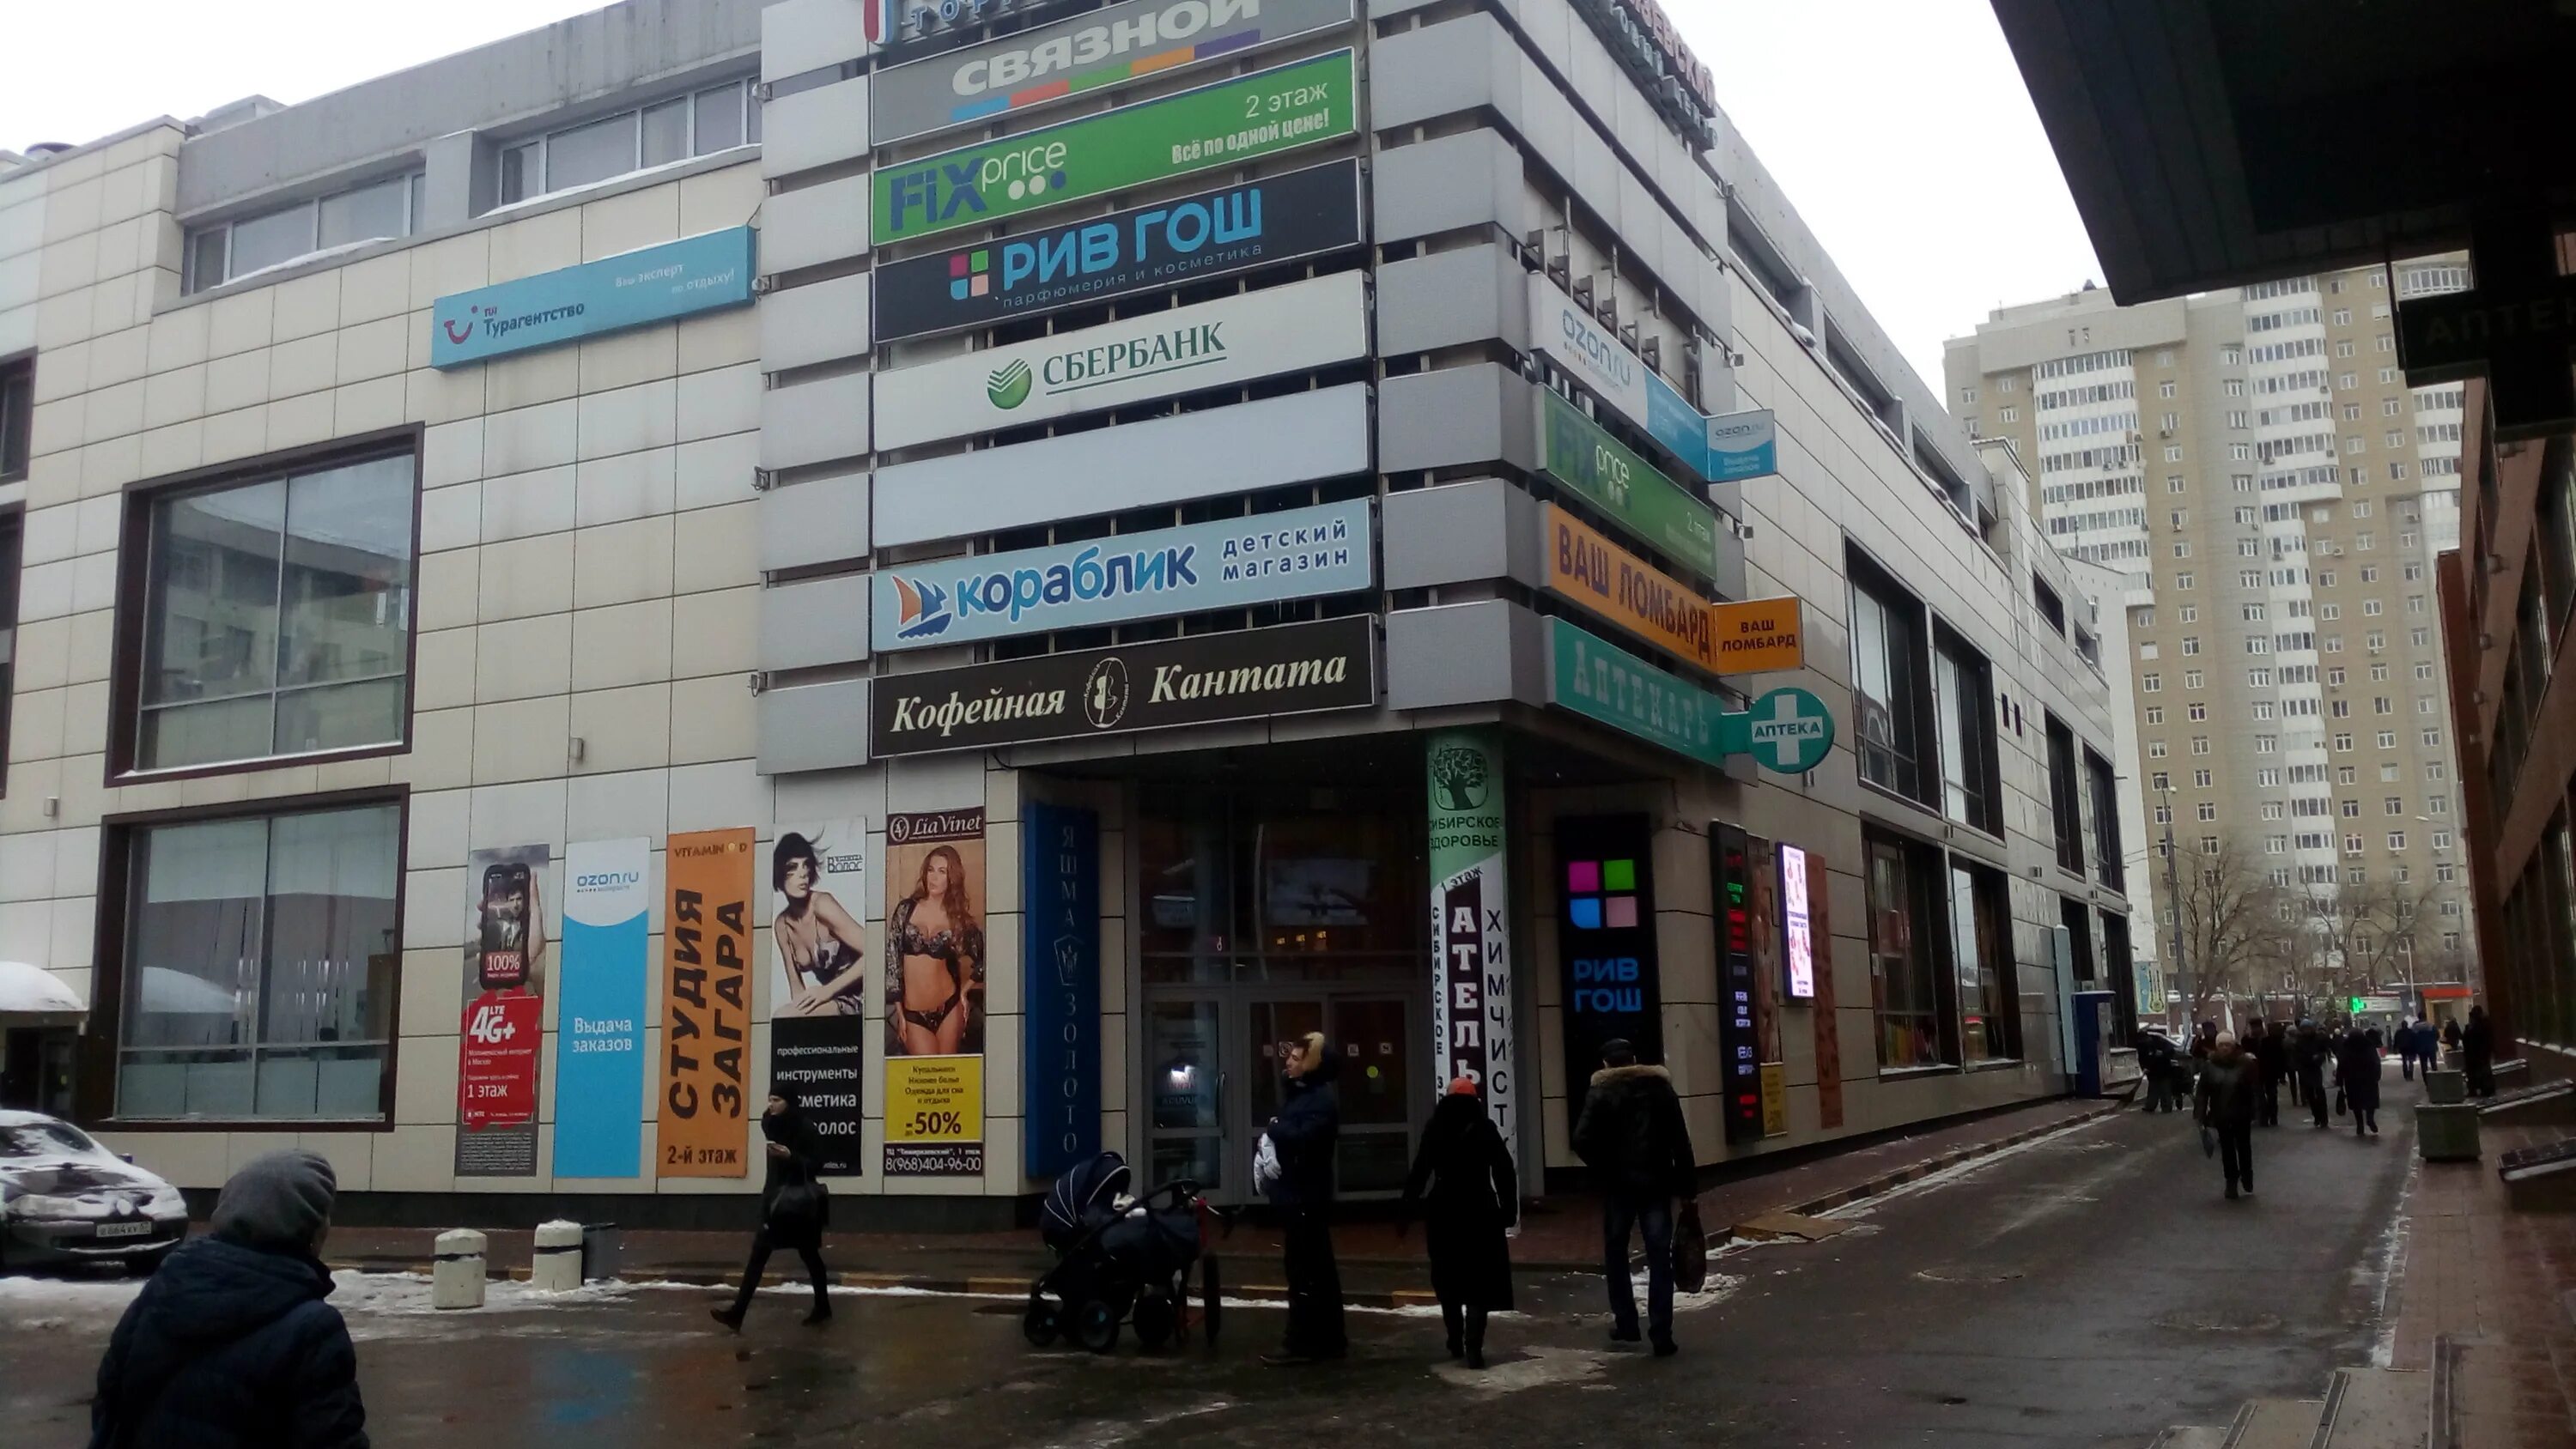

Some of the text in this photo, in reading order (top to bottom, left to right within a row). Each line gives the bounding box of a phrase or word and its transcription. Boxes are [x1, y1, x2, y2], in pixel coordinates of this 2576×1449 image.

[1246, 82, 1328, 118] 2 этаж
[1172, 107, 1330, 164] Всё по одной цене!
[982, 142, 1067, 192] price
[1003, 188, 1262, 291] РИВ ГОШ
[638, 264, 684, 282] эксперт
[686, 268, 735, 290] отдыху!
[1003, 244, 1263, 309] парфюмерия и косметика
[483, 303, 585, 339] Турагентство
[1043, 321, 1226, 386] СБЕРБАНК
[1224, 519, 1348, 560] детский
[1224, 550, 1348, 582] магазин
[956, 546, 1198, 622] кораблик
[1558, 522, 1610, 599] ВАШ
[1619, 561, 1712, 666] ЛОМБАРД
[1740, 619, 1775, 634] ВАШ
[1722, 634, 1796, 652] ЛОМБАРД
[890, 655, 1348, 737] Кофейная Кантата
[1754, 721, 1821, 738] АПТЕКА
[675, 843, 748, 858] VITAMIN D
[1060, 825, 1078, 928] ЯШМА
[1449, 865, 1484, 888] этаж
[487, 954, 520, 971] 100%
[1573, 957, 1638, 982] РИВ
[1431, 906, 1444, 1056] СИБИРСКОЕ
[668, 888, 708, 1119] СТУДИЯ
[1450, 906, 1482, 1087] АТЕЛЬ
[1574, 988, 1642, 1012] ГОШ
[489, 1004, 505, 1016] LTE
[711, 900, 745, 1119] ЗАГАРА
[469, 1005, 516, 1044] 4G+
[574, 1017, 633, 1035] Выдача
[572, 1038, 633, 1053] заказов
[776, 1045, 860, 1058] профессиональные
[776, 1068, 859, 1083] инструменты
[1063, 992, 1078, 1154] ЗОЛОТО
[467, 1084, 508, 1098] 1 этаж
[813, 1121, 857, 1136] олос
[905, 1111, 962, 1136] -50%
[667, 1145, 738, 1165] 2-й этаж
[885, 1157, 981, 1173] 8(968)404-96-00
